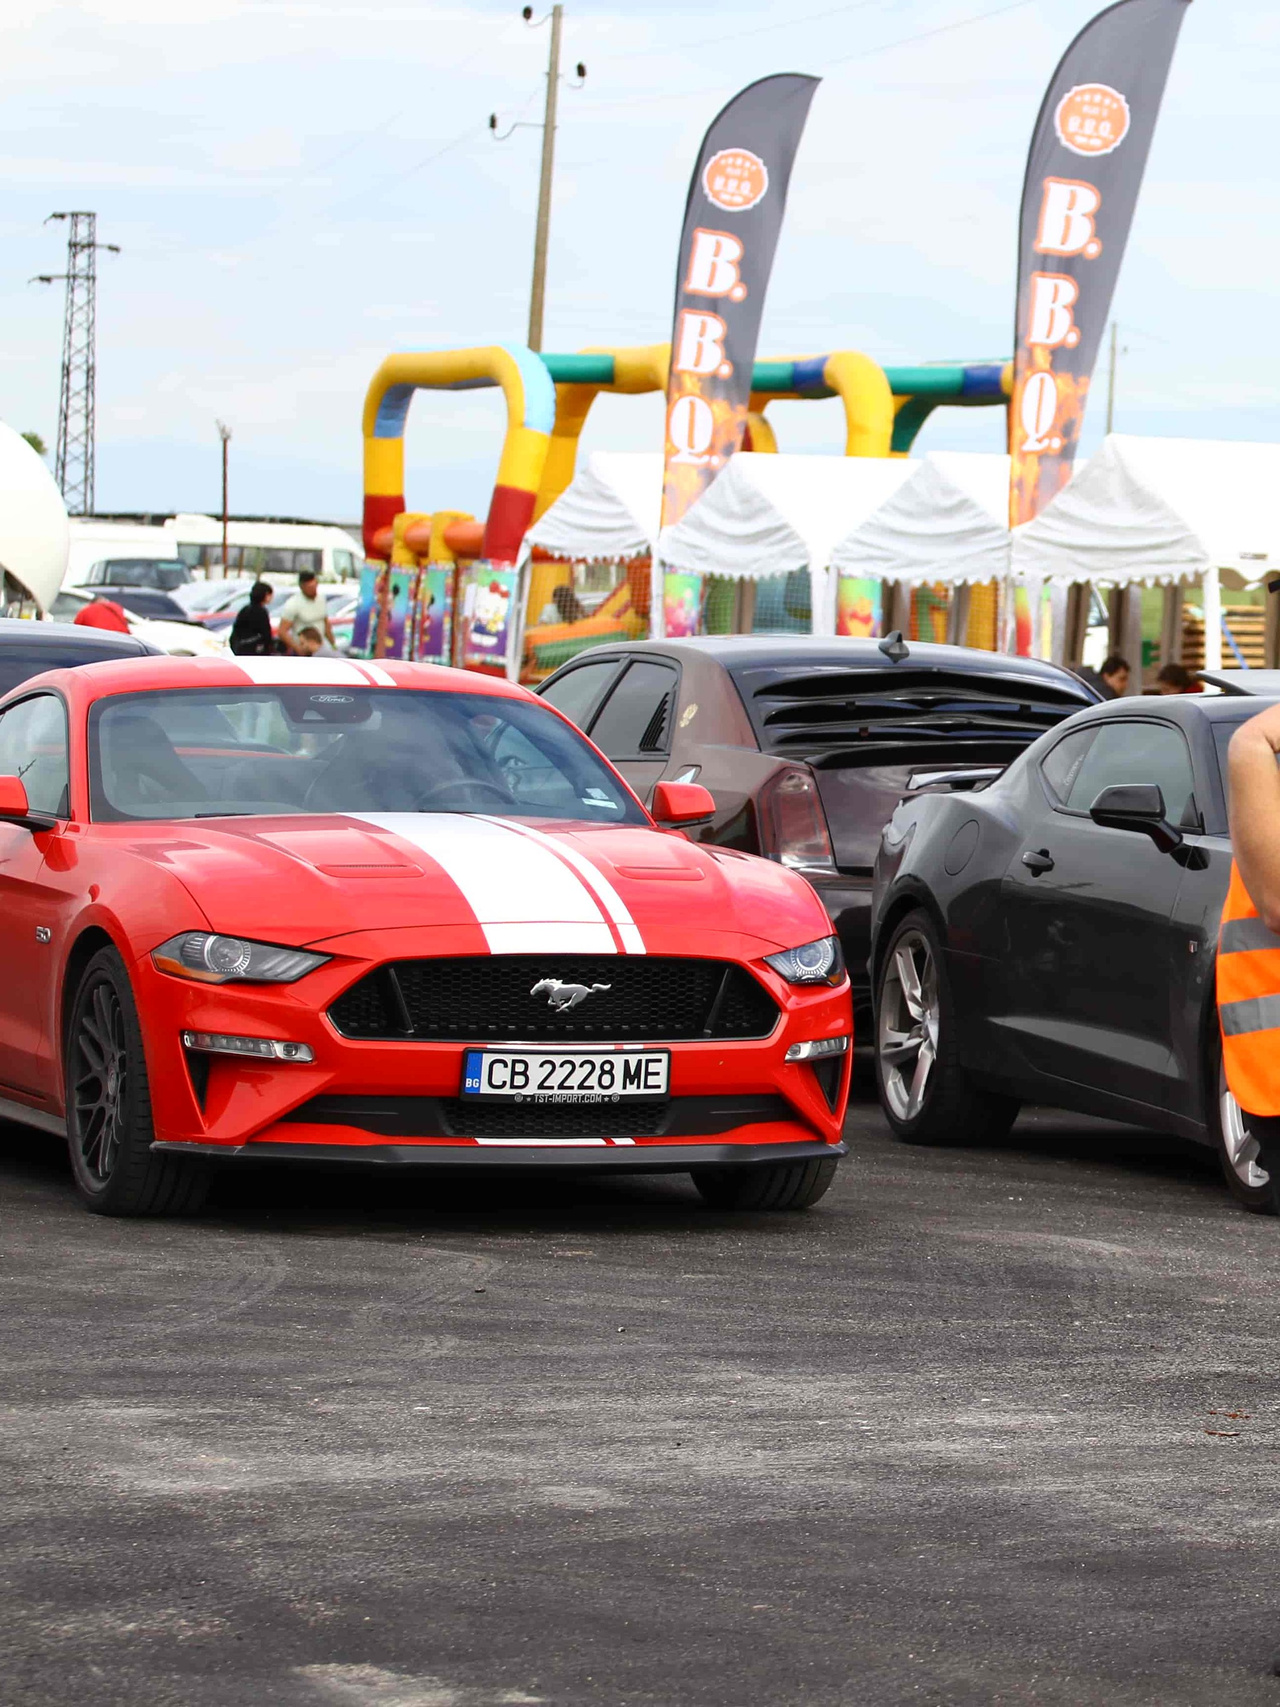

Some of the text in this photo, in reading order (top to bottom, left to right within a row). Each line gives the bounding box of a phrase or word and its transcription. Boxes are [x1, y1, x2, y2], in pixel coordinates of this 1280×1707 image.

[465, 1058, 663, 1091] BG CB 2228 ME
[534, 1093, 602, 1103] TST-IMPORT.COM
